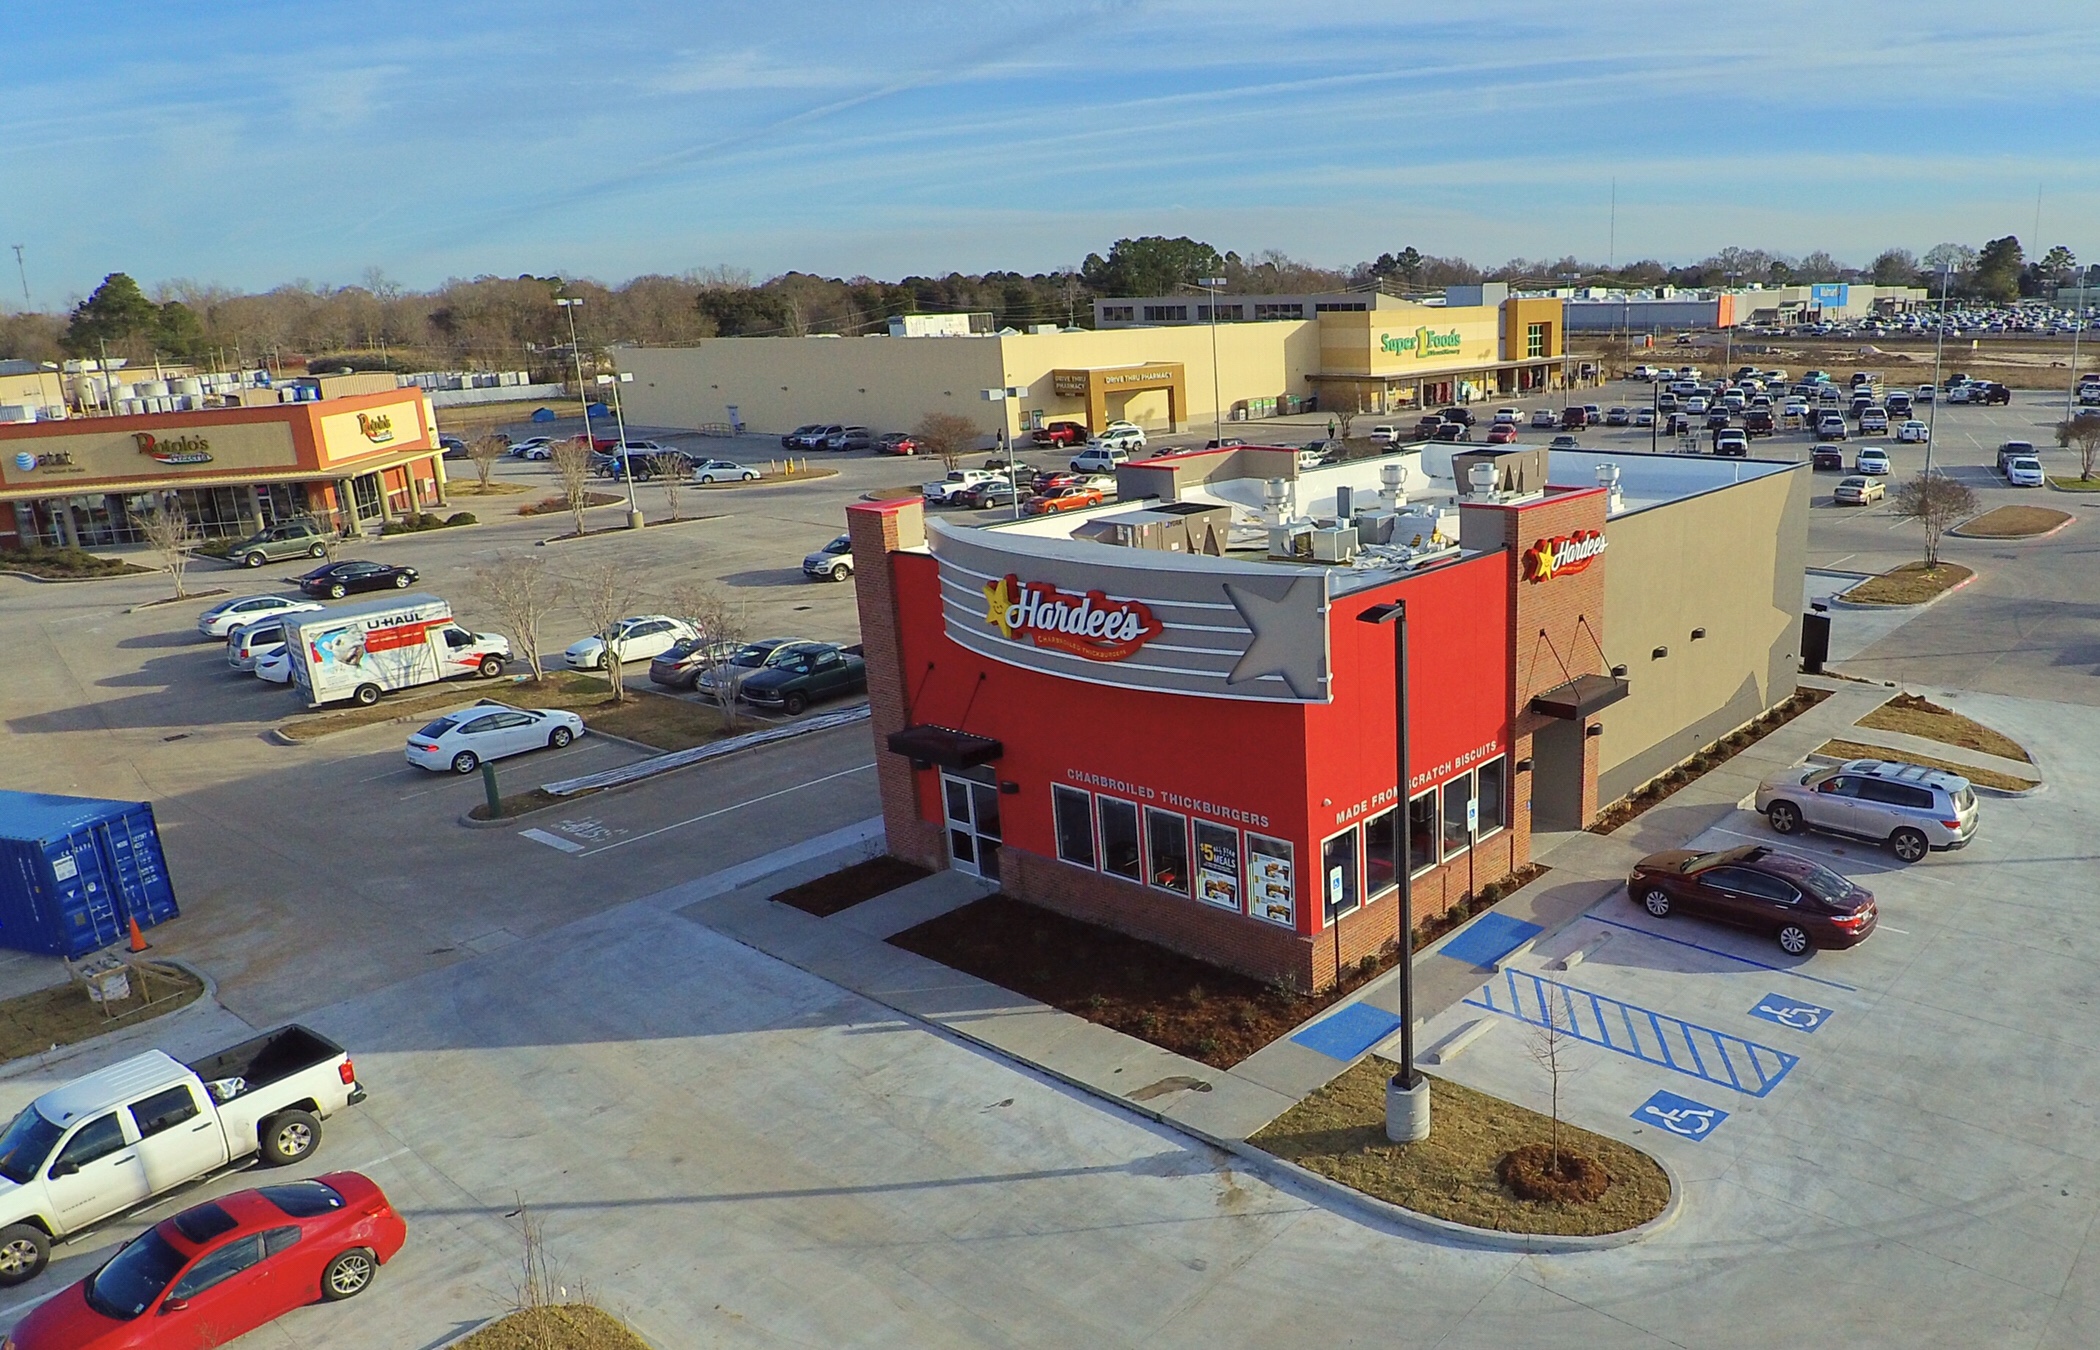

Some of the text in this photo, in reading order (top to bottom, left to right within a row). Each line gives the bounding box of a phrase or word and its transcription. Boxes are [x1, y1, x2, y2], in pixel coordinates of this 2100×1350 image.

[1381, 326, 1461, 358] Super 1 Foods
[1056, 382, 1085, 390] PHARMACY
[1106, 371, 1173, 384] DRIVE THRU PHARMACY
[131, 432, 209, 453] Rotolo's
[1551, 533, 1608, 571] Hardee's
[1005, 589, 1149, 641] Hardee's
[1336, 800, 1367, 825] MADE
[1455, 740, 1497, 769] BISCUITS
[1066, 768, 1270, 828] CHARBROILED THICKBURGERS
[1200, 843, 1213, 862] $5
[1213, 854, 1236, 869] MEALS
